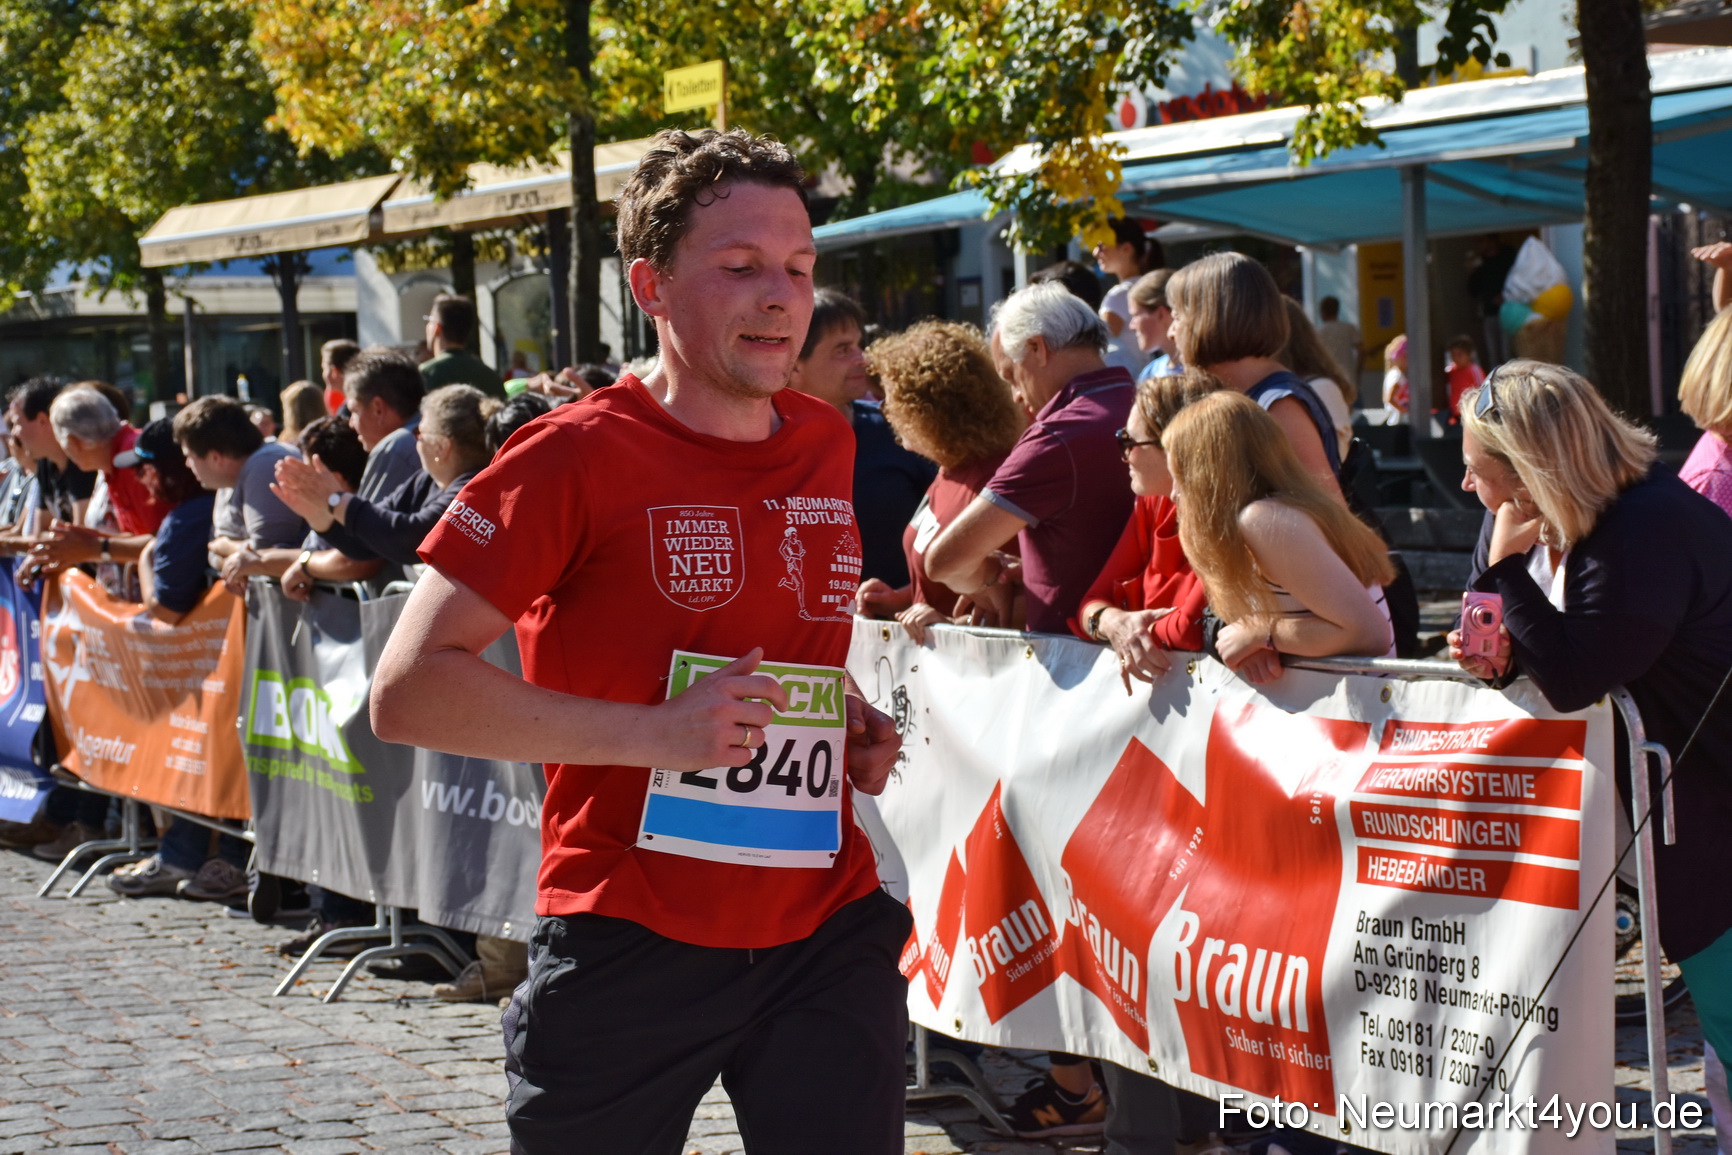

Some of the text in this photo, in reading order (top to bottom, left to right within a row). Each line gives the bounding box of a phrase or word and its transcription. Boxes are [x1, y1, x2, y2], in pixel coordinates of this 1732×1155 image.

[676, 79, 718, 98] Toiletten
[763, 498, 786, 511] 11.
[786, 511, 853, 526] STADTLAUF
[663, 536, 735, 552] WIEDER
[666, 520, 730, 534] IMMER
[669, 553, 732, 576] NEU
[669, 578, 734, 593] MARKT
[76, 727, 136, 766] Agentur
[1391, 727, 1494, 751] BINDESTRICKE
[1368, 768, 1536, 799] VERZURRSYSTEME
[1309, 792, 1323, 825] Seit
[1361, 810, 1521, 846] RUNDSCHLINGEN
[1169, 825, 1204, 881] Seit 1929
[1367, 856, 1486, 892] HEBEBÄNDER
[965, 899, 1050, 989] Braun
[1060, 865, 1140, 1004] Braun
[1356, 910, 1466, 945] Braun GmbH
[1172, 908, 1309, 1033] Braun
[1353, 940, 1480, 983] Am Grünberg 8
[1354, 970, 1559, 1032] D-92318 Neumarkt-Pölling
[1225, 1026, 1332, 1071] Sicher ist sicher
[1359, 1011, 1495, 1060] Tel. 09181 / 2307-0
[1361, 1042, 1385, 1069] Fax
[1390, 1048, 1433, 1078] 09181
[1440, 1056, 1447, 1081] /
